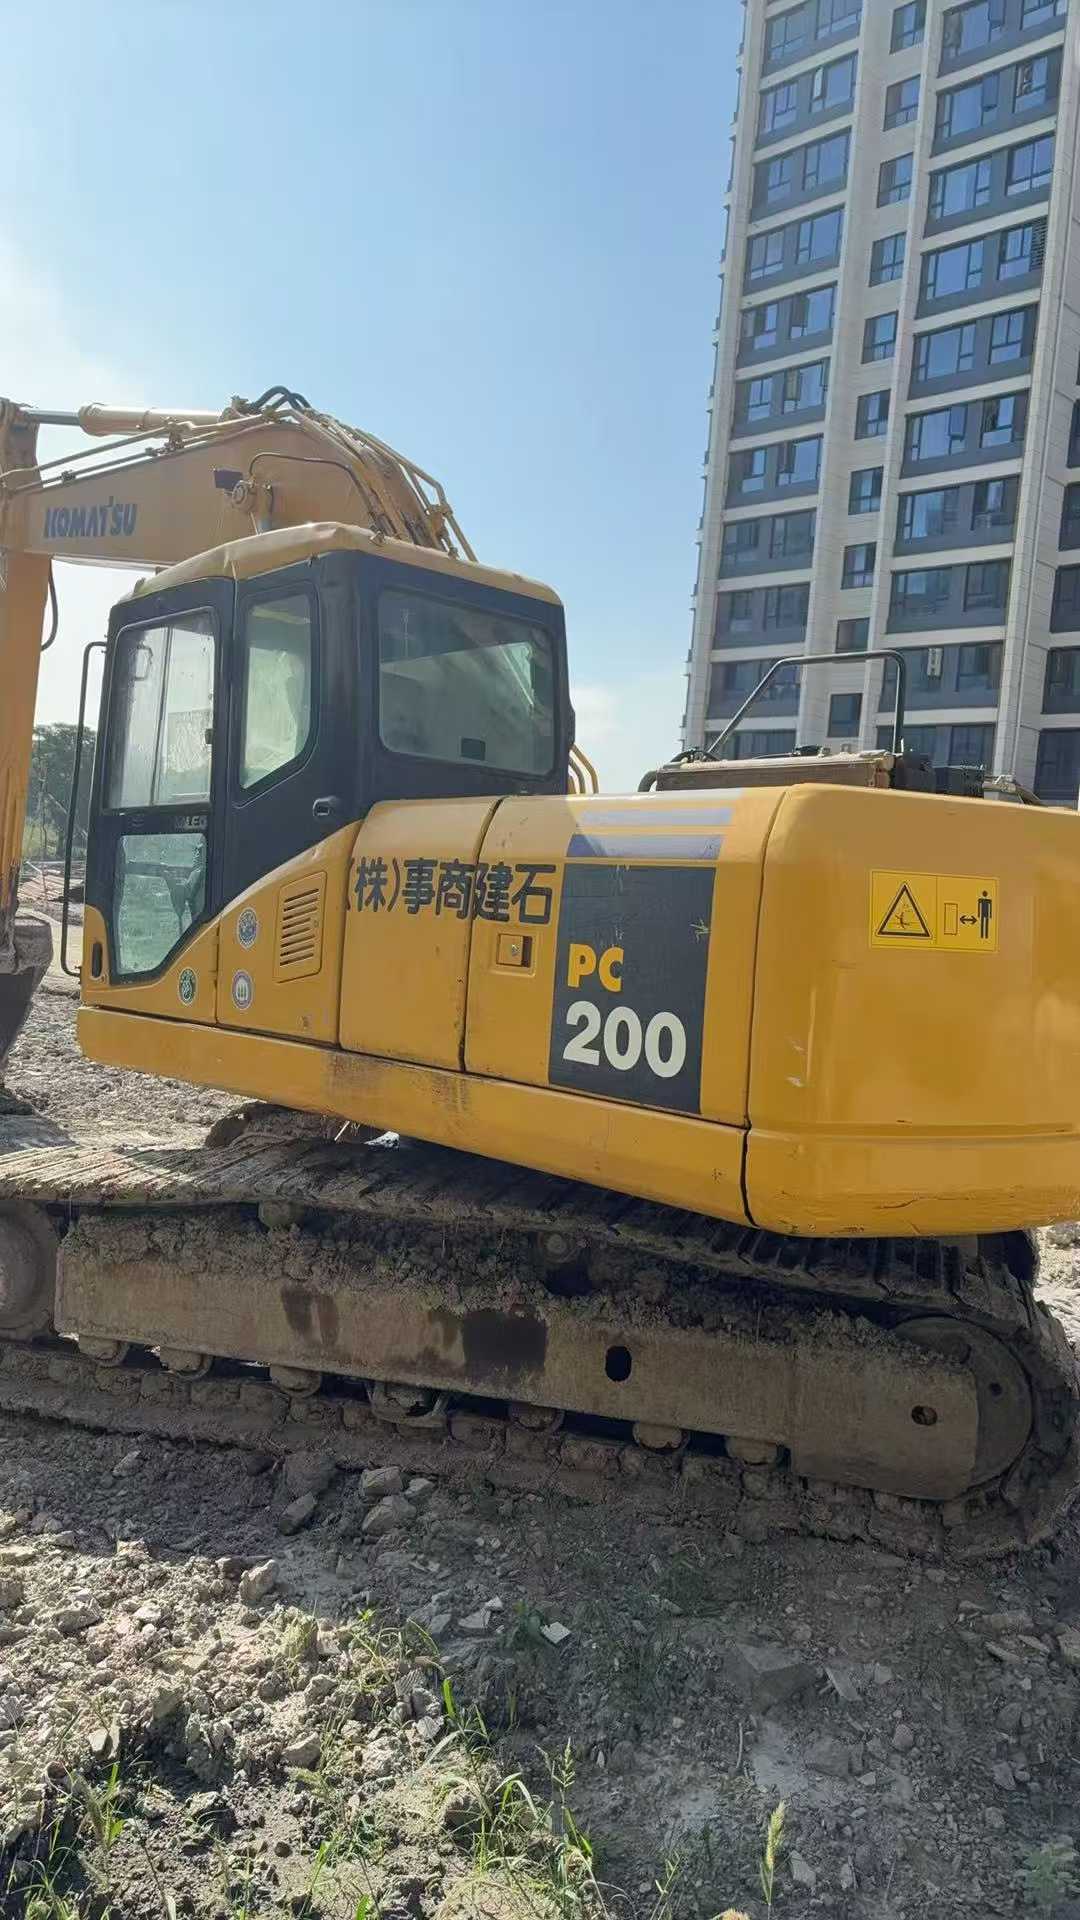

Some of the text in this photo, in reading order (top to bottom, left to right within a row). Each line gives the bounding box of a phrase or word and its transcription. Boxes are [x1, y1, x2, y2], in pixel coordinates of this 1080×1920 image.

[43, 496, 138, 538] KOMATSU
[567, 943, 625, 993] PC
[562, 1000, 687, 1078] 200
